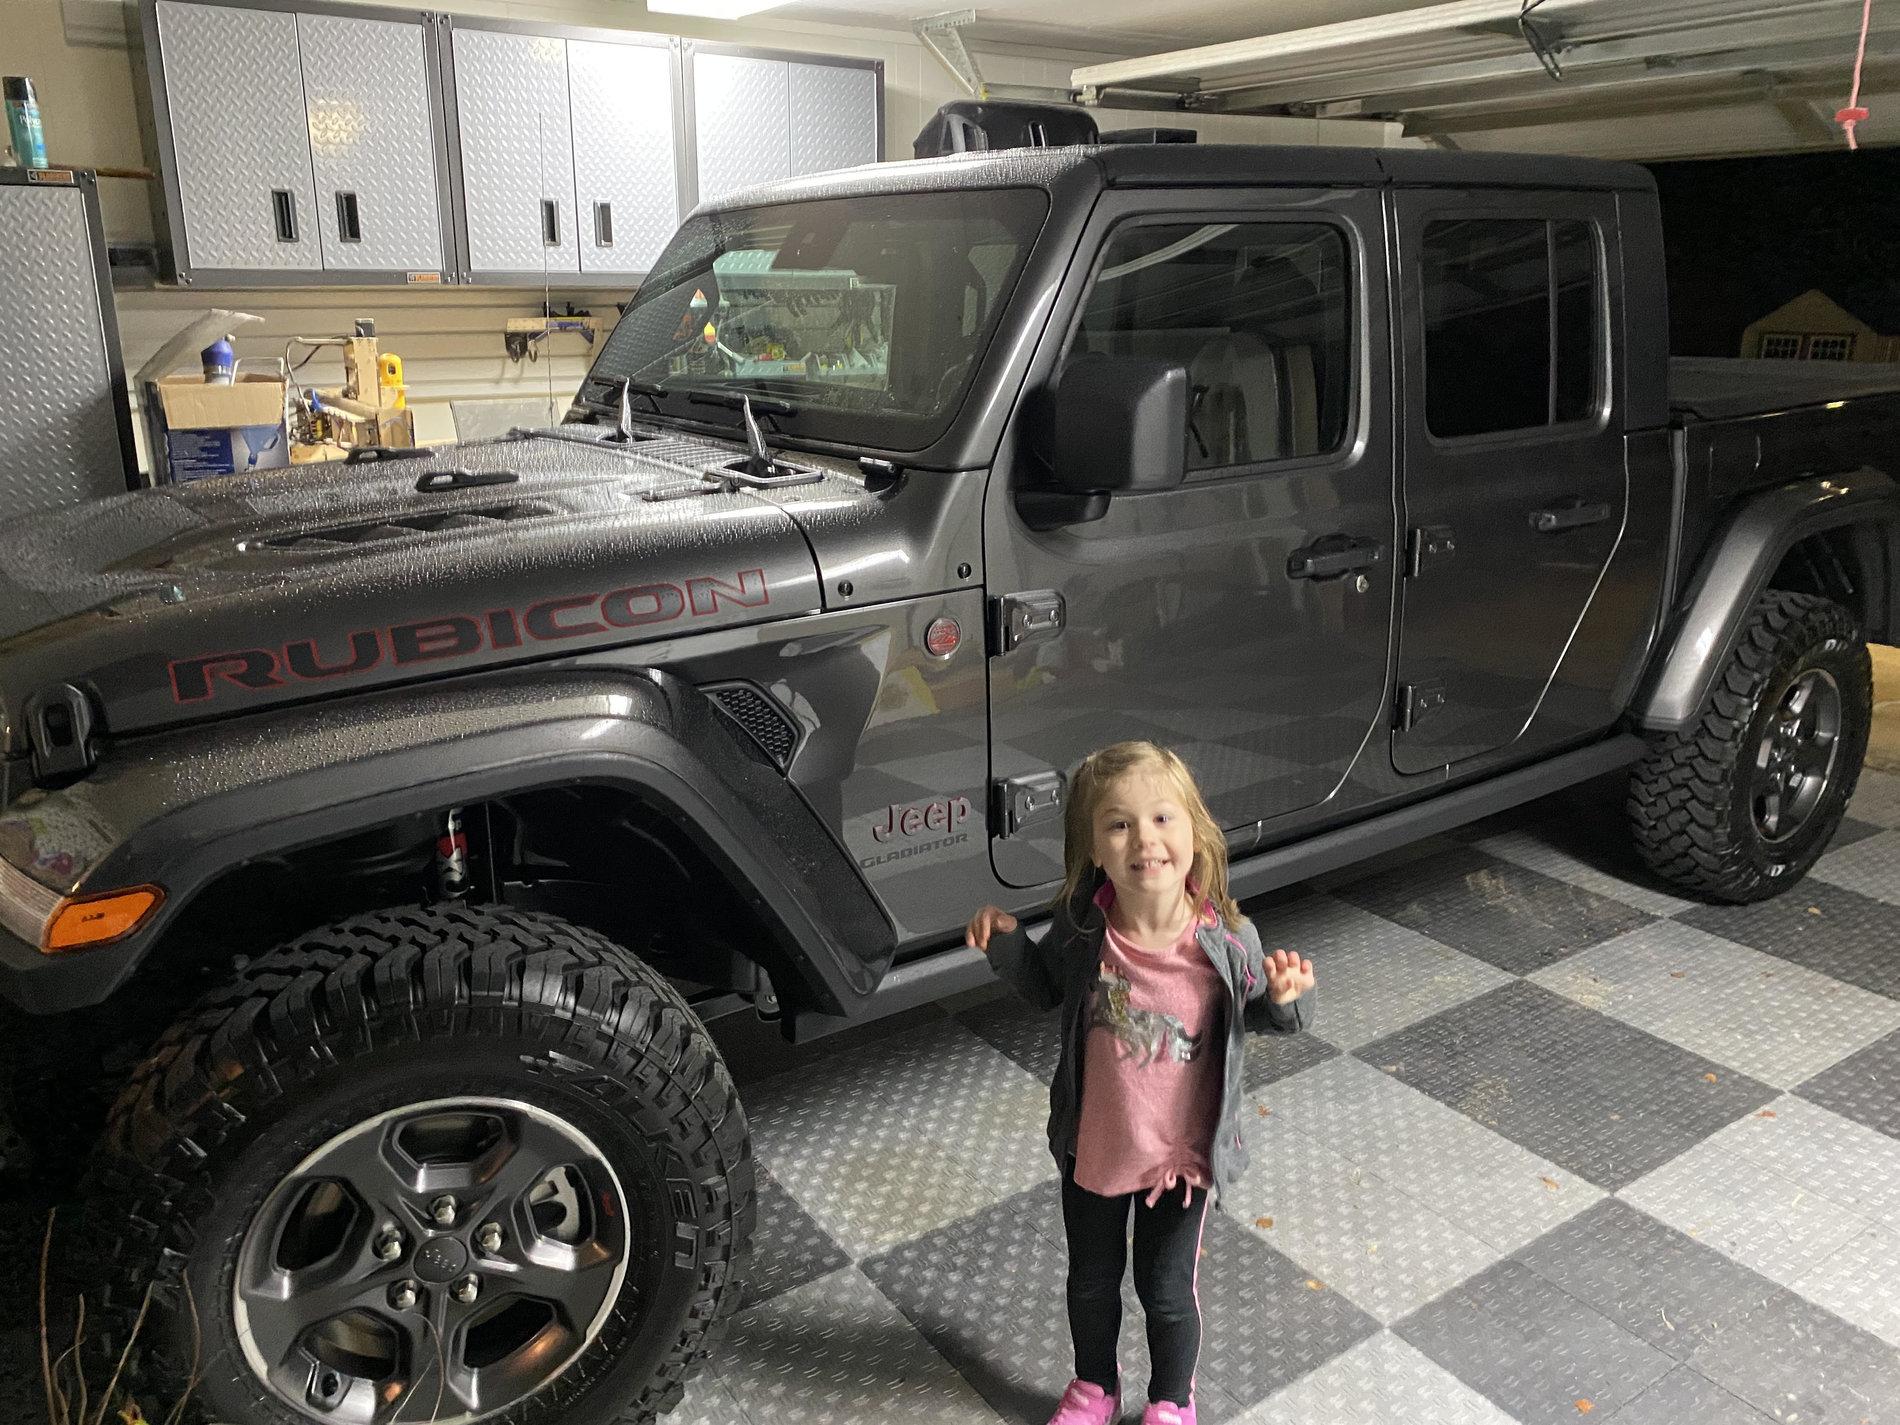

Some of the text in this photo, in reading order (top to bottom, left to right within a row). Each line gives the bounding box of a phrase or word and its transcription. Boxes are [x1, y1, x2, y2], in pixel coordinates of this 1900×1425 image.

[167, 568, 770, 705] RUBICON
[872, 796, 972, 844] Jeep
[860, 833, 968, 869] GLADIATOR
